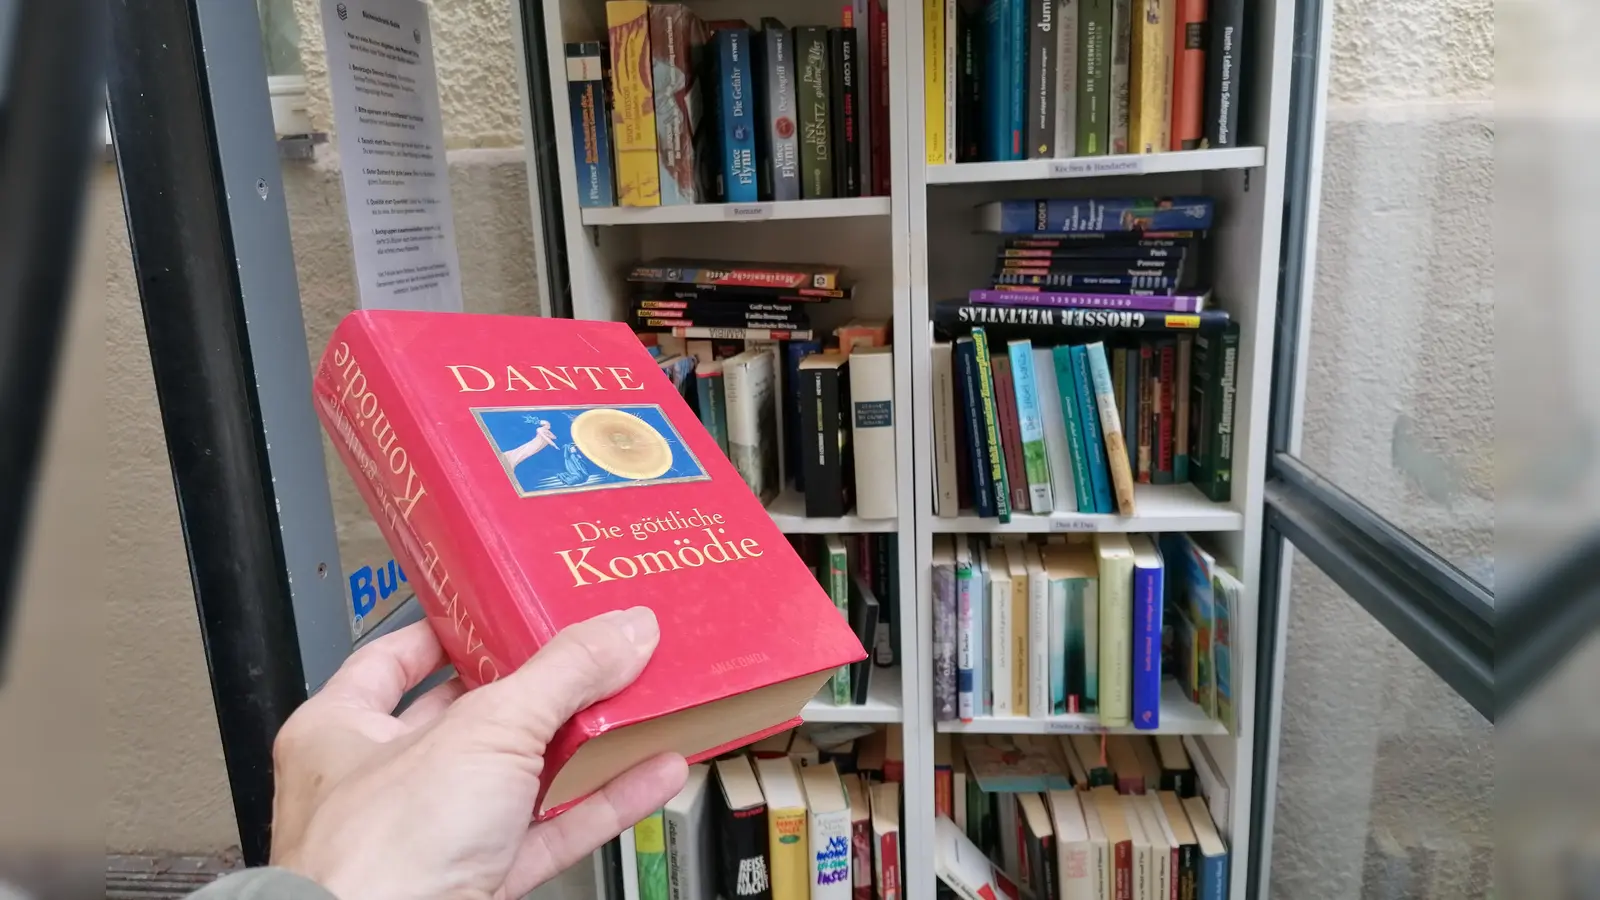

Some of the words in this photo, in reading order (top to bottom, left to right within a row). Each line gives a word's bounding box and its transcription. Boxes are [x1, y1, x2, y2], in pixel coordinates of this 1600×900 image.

[1087, 21, 1096, 75] AUSERWÄHLTEN
[1224, 26, 1234, 51] Ruete
[843, 41, 851, 61] LIZA
[803, 65, 814, 83] Das
[843, 62, 852, 87] CODY
[1221, 55, 1233, 80] Leben
[731, 67, 743, 101] Gefahr
[778, 65, 791, 97] Angriff
[733, 102, 743, 117] Die
[778, 98, 787, 112] Der
[1218, 93, 1231, 145] Sultanspalast
[805, 121, 816, 144] INY
[815, 103, 828, 161] LORENTZ
[732, 149, 742, 176] Vince
[740, 149, 756, 186] Flynn
[775, 142, 784, 169] Vince
[782, 142, 797, 179] Flynn
[1054, 163, 1083, 174] Kochen
[1085, 163, 1092, 172] &
[734, 207, 762, 215] Romane
[1037, 202, 1047, 231] DUDEN
[1137, 259, 1165, 267] Provence
[1150, 249, 1168, 257] Paris
[705, 270, 732, 281] Feste
[736, 270, 796, 285] Mexikanische
[642, 301, 658, 309] ADAC
[771, 303, 792, 311] Neapel
[1050, 296, 1132, 307] ORTSWECHSEL
[647, 319, 663, 327] ADAC
[958, 306, 1054, 325] WELTATLAS
[1061, 309, 1145, 328] GROSSER
[709, 328, 746, 339] NAMIBIA
[446, 364, 645, 393] DANTE
[1218, 347, 1237, 435] Zimmerpflanzen
[333, 341, 429, 521] Komödie
[1024, 415, 1036, 432] Die
[329, 394, 379, 481] göttliche
[374, 480, 398, 531] Die
[571, 519, 622, 544] Die
[631, 508, 726, 542] göttliche
[1081, 521, 1094, 529] Das
[554, 526, 765, 588] Komödie
[421, 540, 501, 685] DANTE
[710, 651, 771, 675] ANACONDA
[739, 855, 765, 871] REISE
[738, 870, 750, 883] IN
